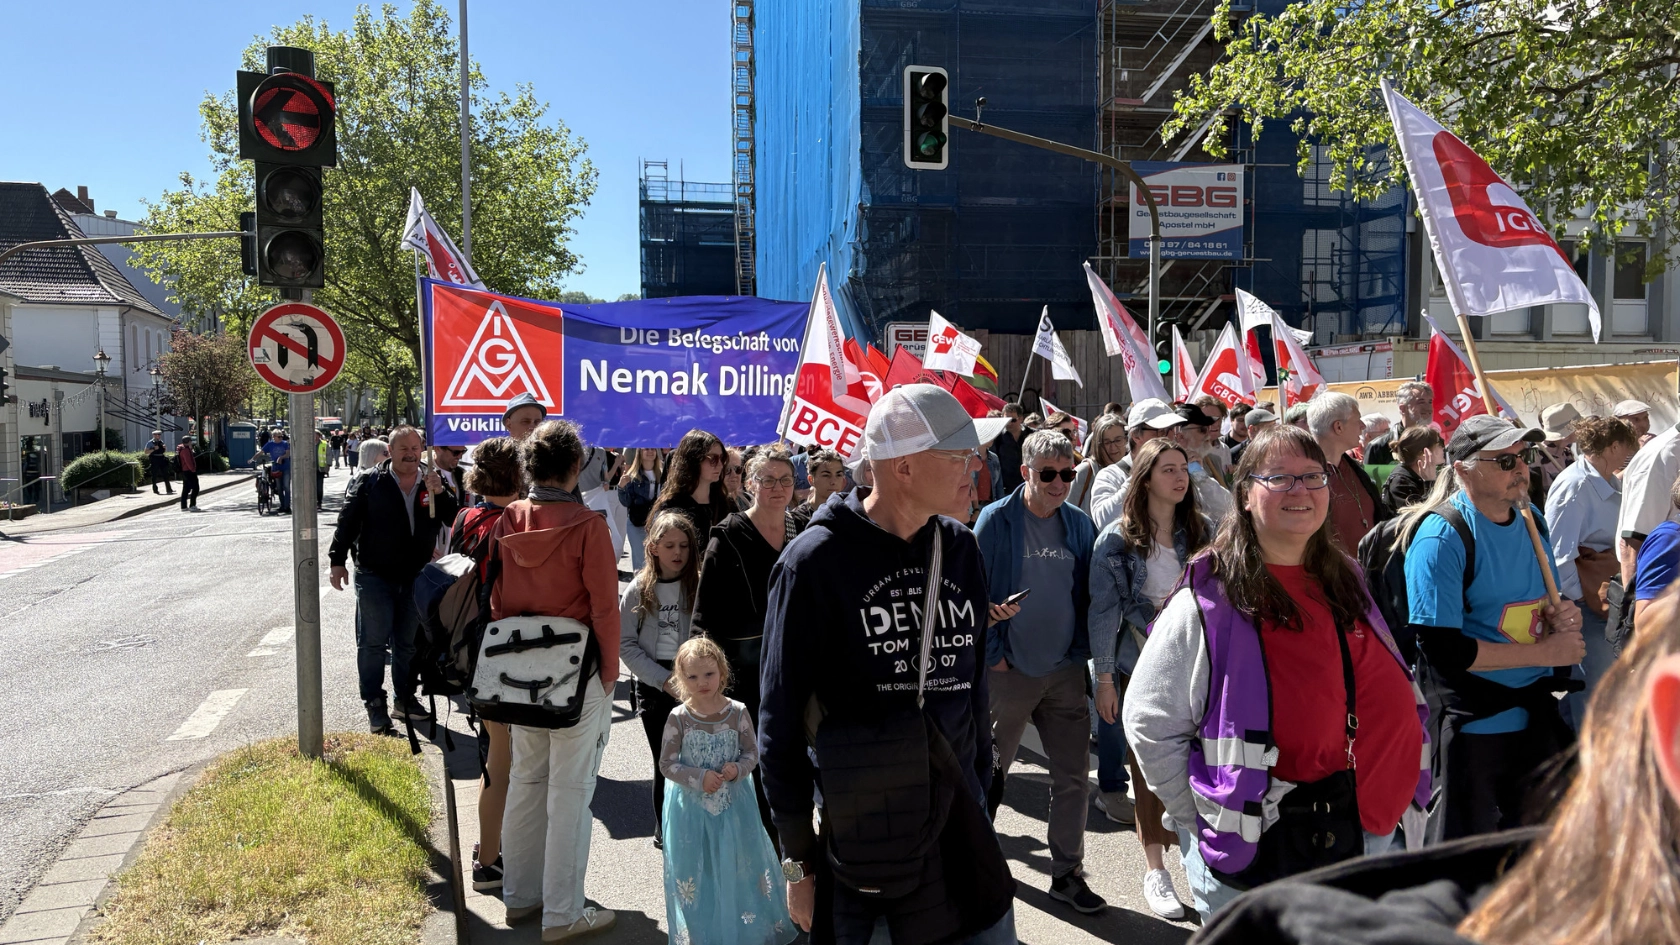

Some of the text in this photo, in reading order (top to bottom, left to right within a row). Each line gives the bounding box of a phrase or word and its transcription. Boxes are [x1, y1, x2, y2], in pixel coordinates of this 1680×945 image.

[1136, 184, 1238, 208] GBG
[1136, 210, 1237, 219] Gestbaugesellschaft
[1495, 212, 1545, 235] IGB
[1159, 221, 1193, 229] Apostel
[1139, 249, 1233, 257] ww.gbg-geruestbau.de
[620, 326, 799, 354] Die Belegschaft von
[931, 333, 957, 347] GEW
[580, 359, 709, 396] Nemak
[863, 575, 892, 602] URBAN
[868, 634, 974, 655] TOM ILOR
[894, 655, 957, 673] 20 07
[876, 683, 893, 691] THE
[952, 681, 972, 691] BRAND
